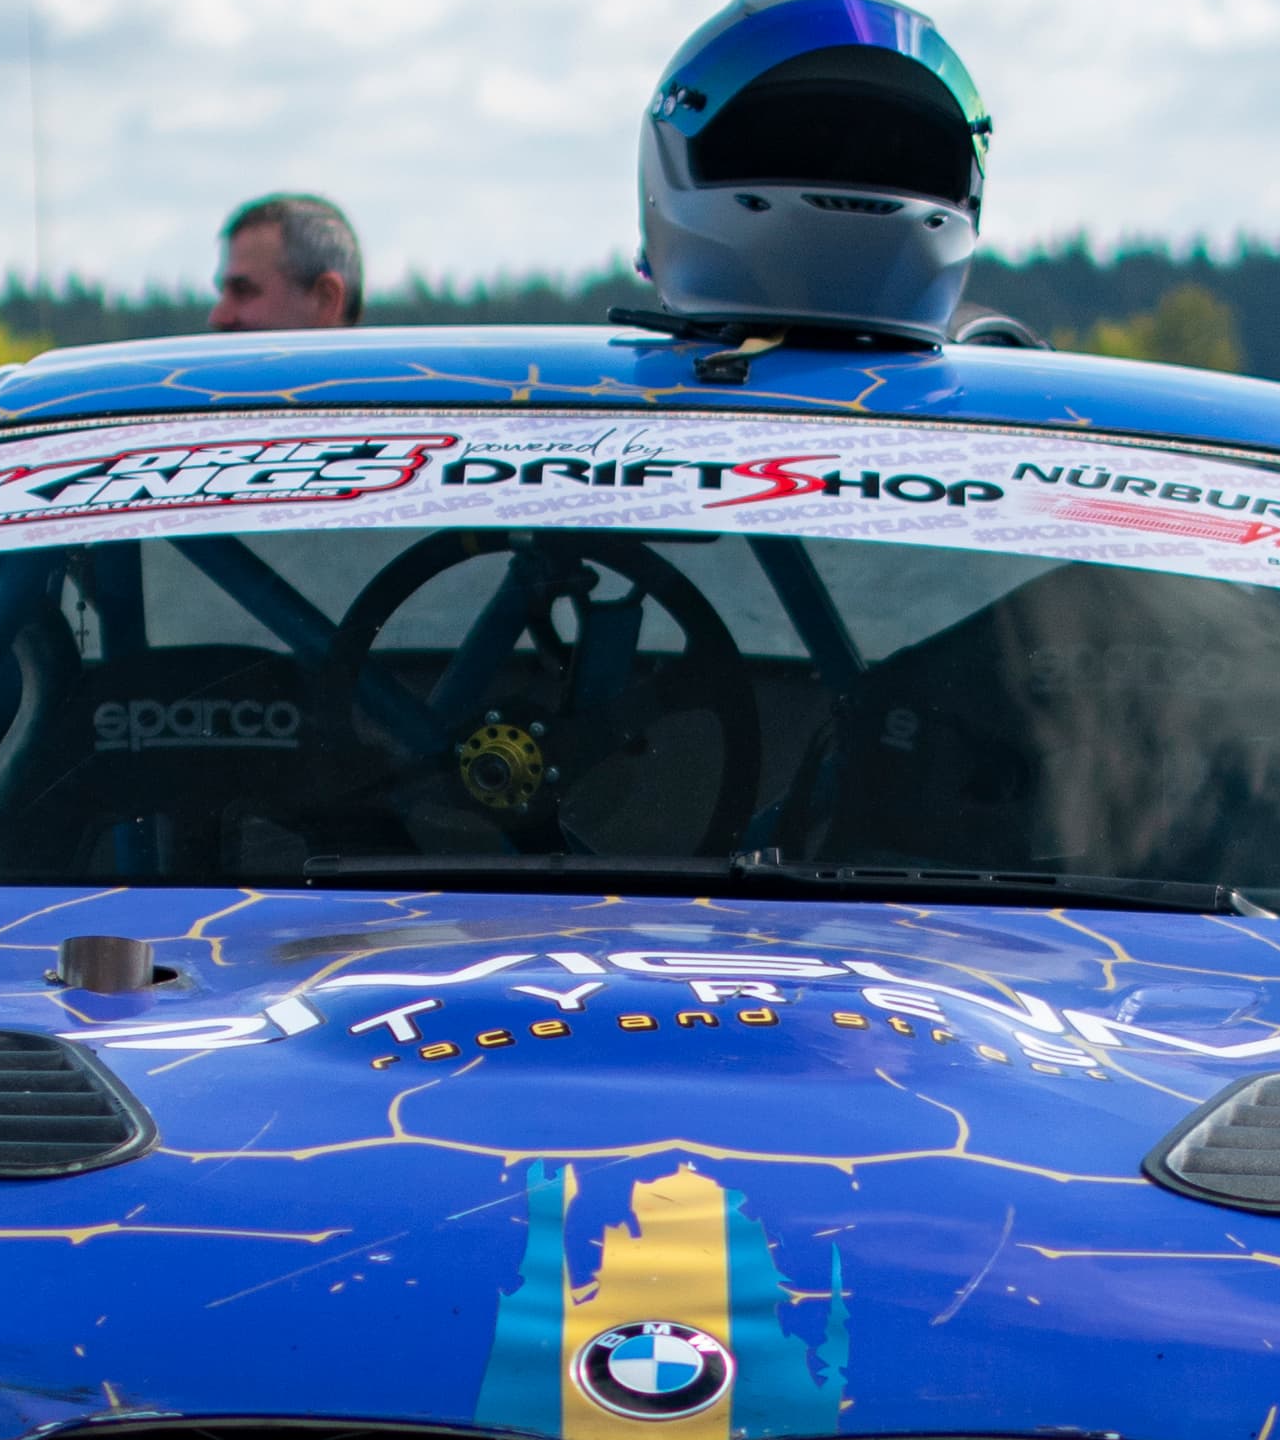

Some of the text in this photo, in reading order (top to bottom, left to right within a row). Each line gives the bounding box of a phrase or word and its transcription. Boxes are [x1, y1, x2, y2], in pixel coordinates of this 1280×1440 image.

[118, 440, 444, 472] DRIFT
[459, 427, 617, 459] powered
[621, 428, 675, 464] by
[232, 487, 339, 501] SERIES
[93, 699, 299, 752] sparco
[347, 978, 1101, 1068] TYRES
[369, 1015, 569, 1071] race
[619, 1006, 778, 1031] and
[596, 1323, 720, 1353] BMW
